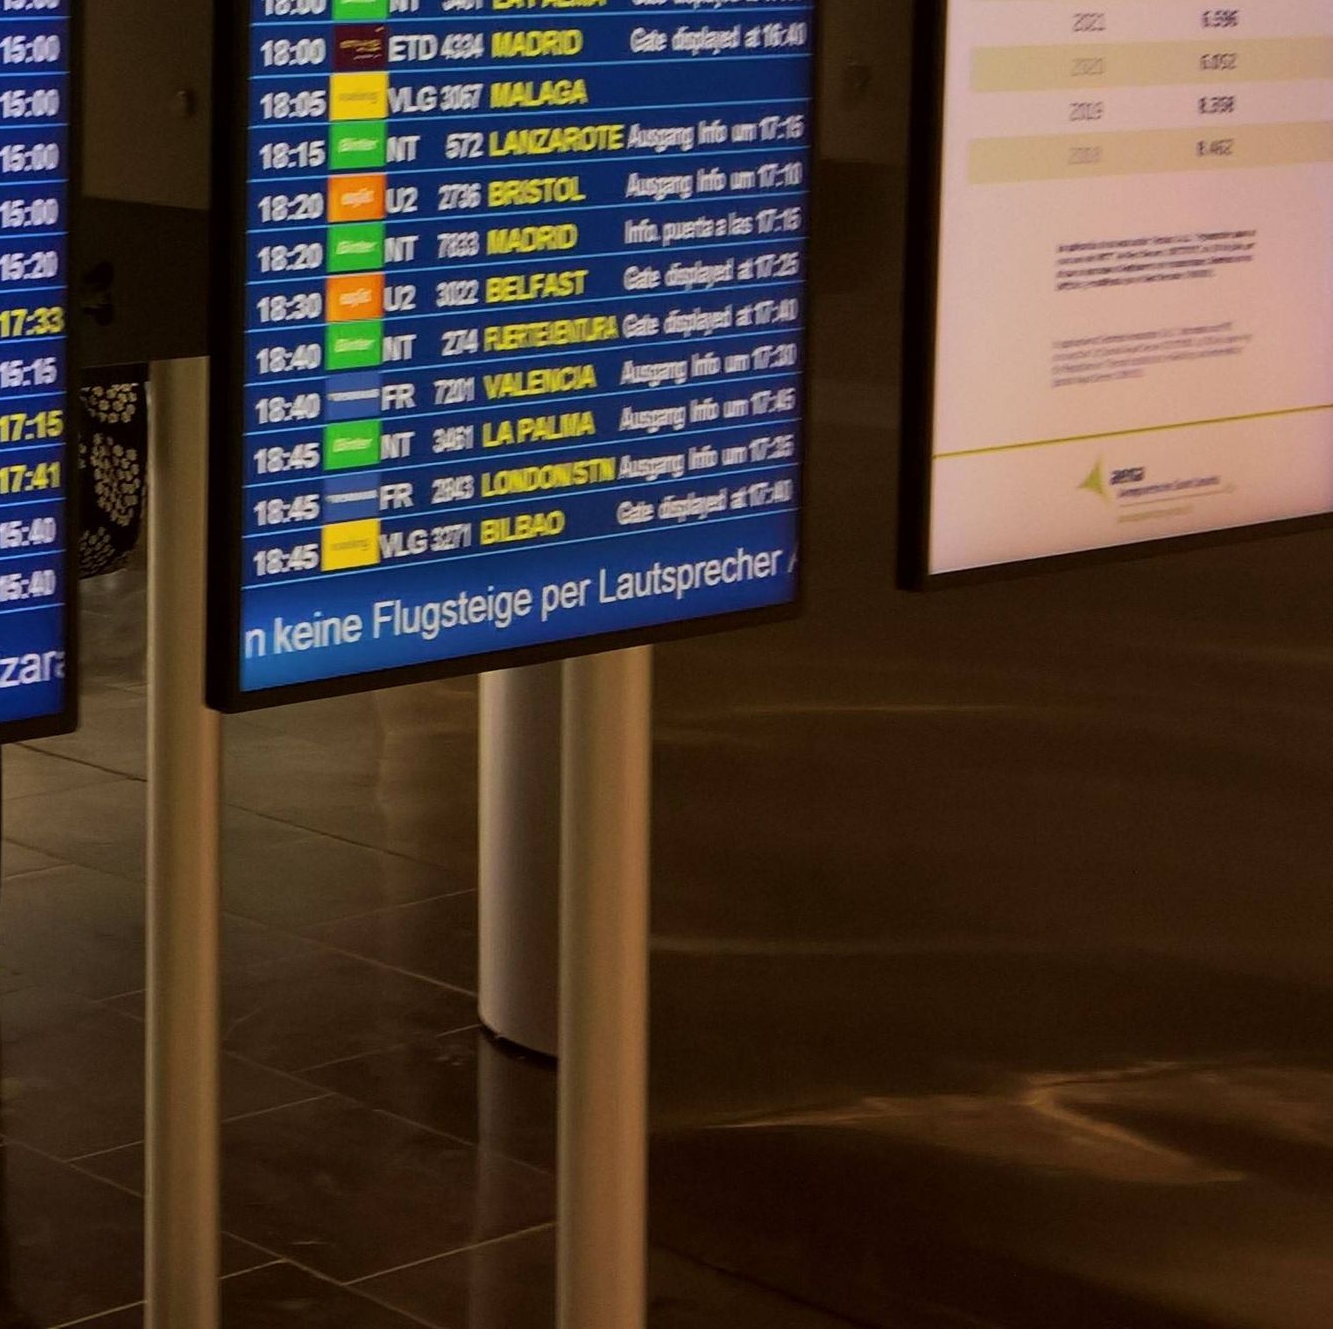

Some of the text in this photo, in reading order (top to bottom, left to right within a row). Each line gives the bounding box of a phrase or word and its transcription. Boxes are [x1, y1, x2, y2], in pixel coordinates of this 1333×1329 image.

[273, 547, 784, 655] keine Flugsteige per Lautsprecher
